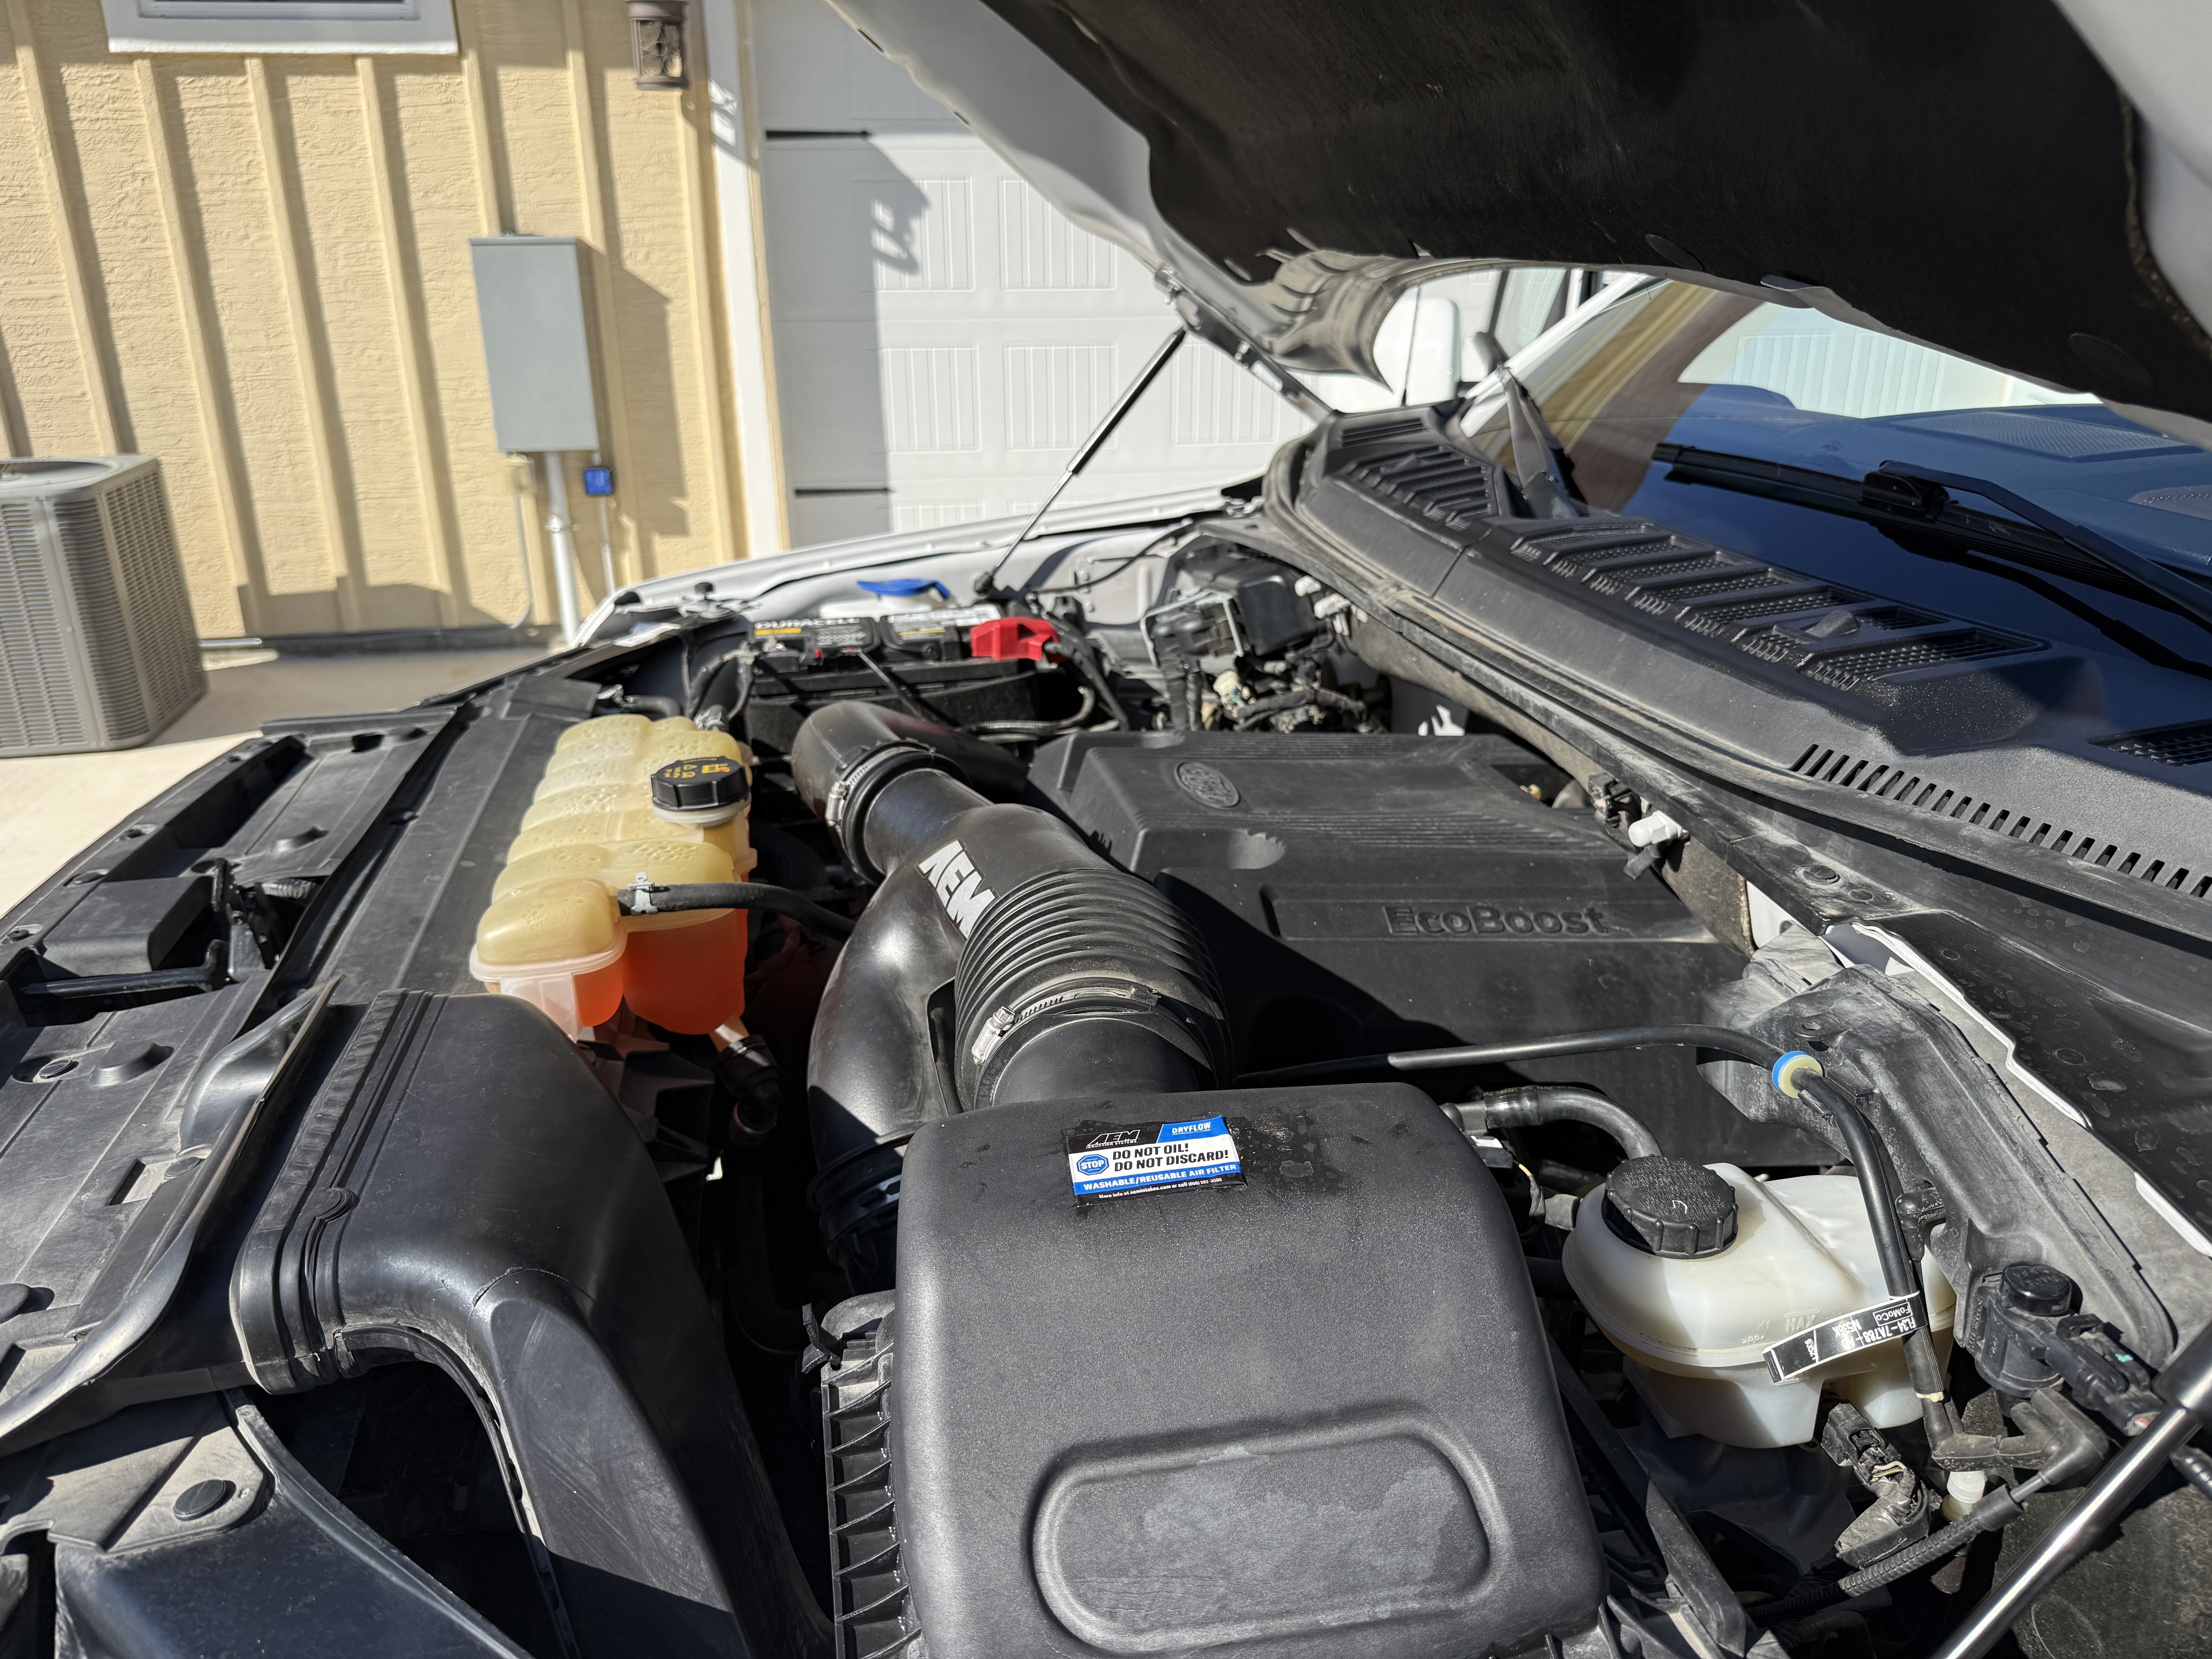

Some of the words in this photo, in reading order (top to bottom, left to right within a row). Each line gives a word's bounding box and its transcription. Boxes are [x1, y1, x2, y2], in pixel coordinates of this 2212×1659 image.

[1382, 906, 1609, 935] EcoBoost
[1172, 1121, 1211, 1133] DRYFLOW
[1087, 1130, 1140, 1147] AEM
[1113, 1150, 1131, 1160] DO
[1135, 1146, 1161, 1158] NOT
[1164, 1143, 1188, 1154] OIL!
[1081, 1159, 1104, 1170] STOP
[1115, 1161, 1133, 1172] DO
[1137, 1157, 1163, 1169] NOT
[1166, 1150, 1229, 1165] DISCARD!
[1084, 1171, 1187, 1190] WASHABLE/REUSABLE
[1206, 1164, 1237, 1174] FILTER
[1876, 1305, 1910, 1321] FoMoCo
[1786, 1314, 1815, 1332] MAX
